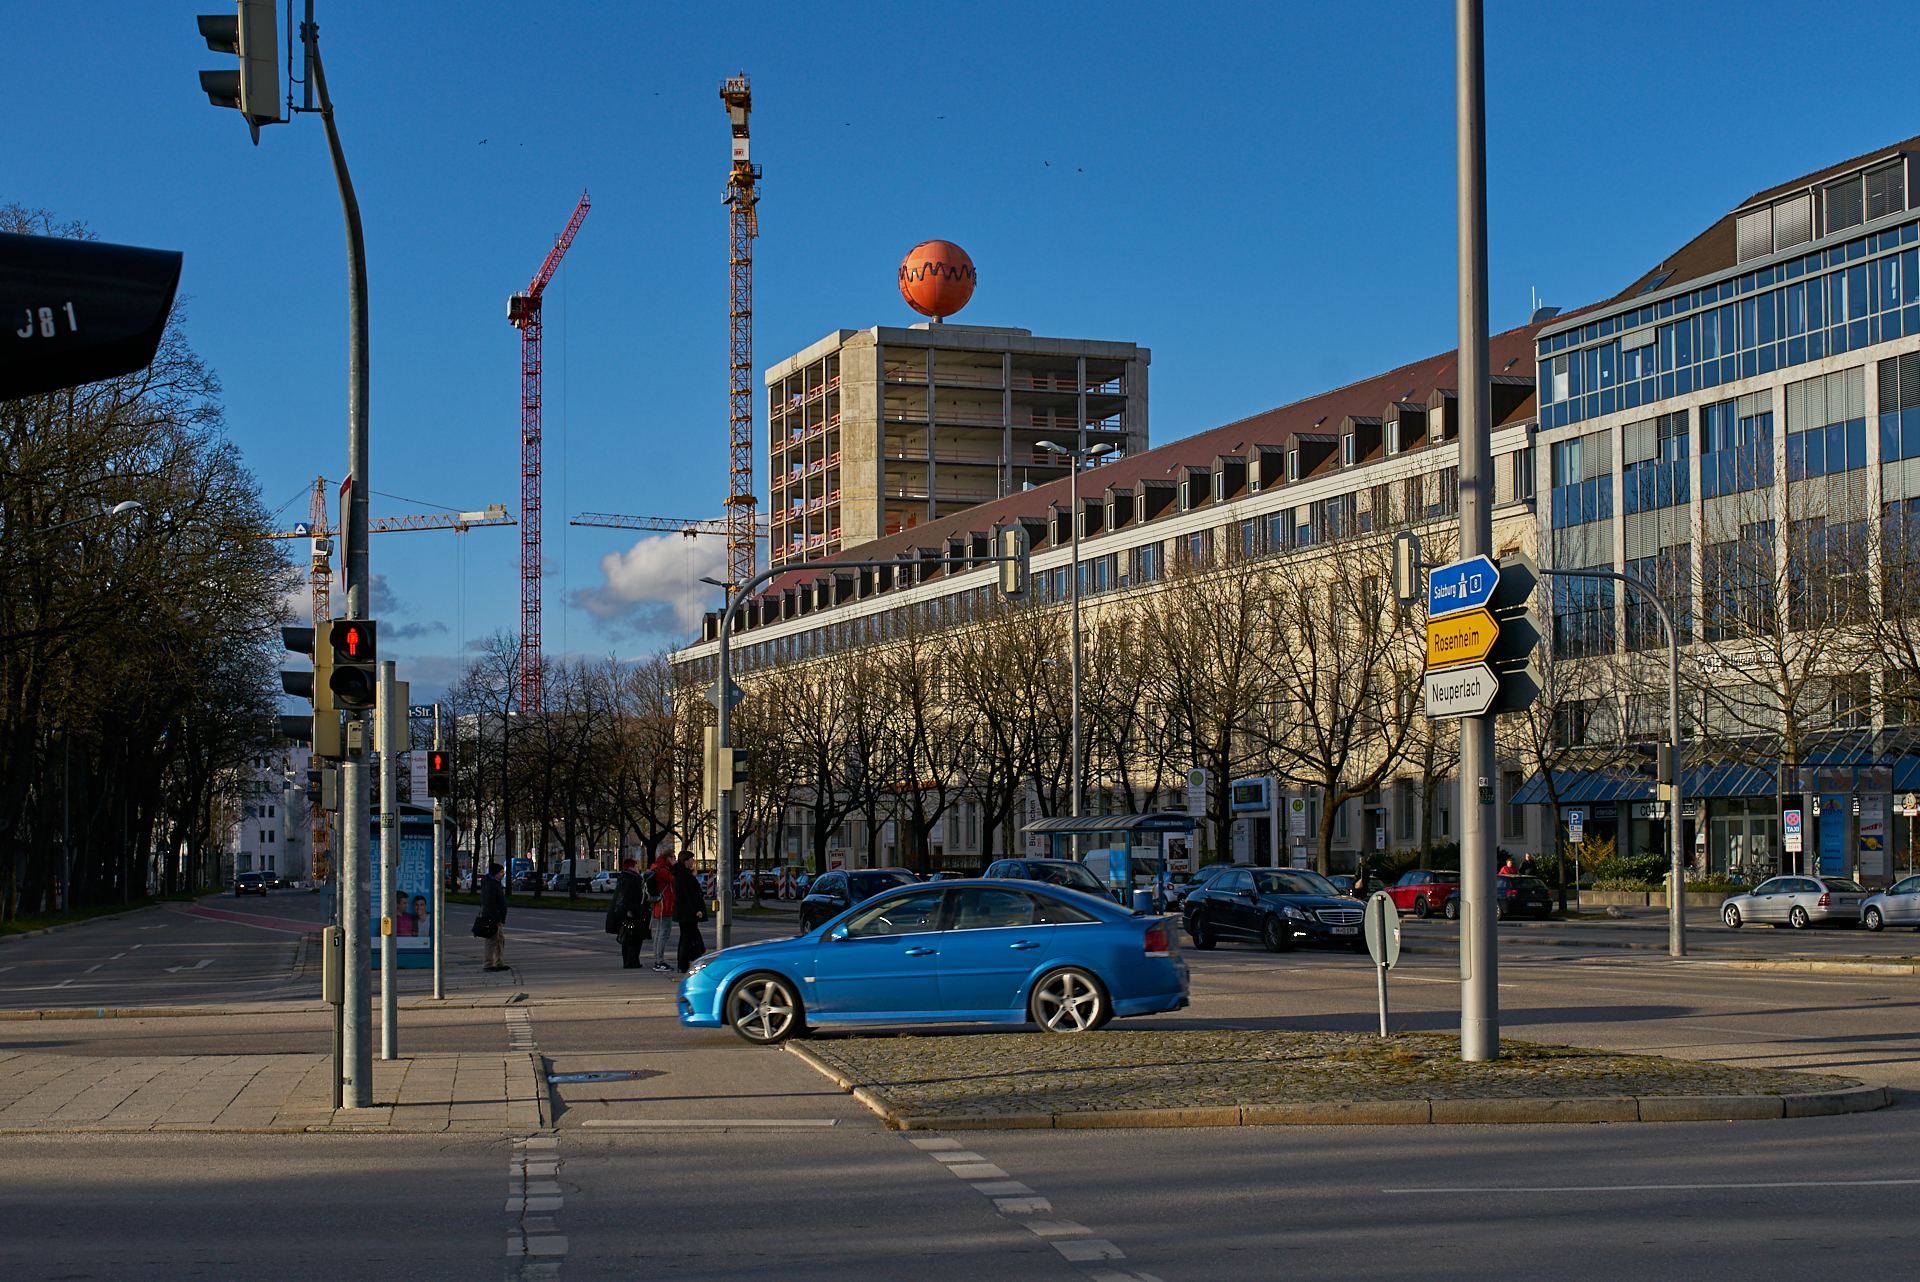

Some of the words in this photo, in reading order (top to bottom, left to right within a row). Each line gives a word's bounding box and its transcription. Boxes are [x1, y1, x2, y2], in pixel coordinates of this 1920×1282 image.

[1434, 584, 1456, 599] Salzburg
[1434, 627, 1479, 653] Rosenheim
[1432, 677, 1480, 705] Neuperlach
[1640, 805, 1656, 816] COR
[334, 937, 339, 946] 1
